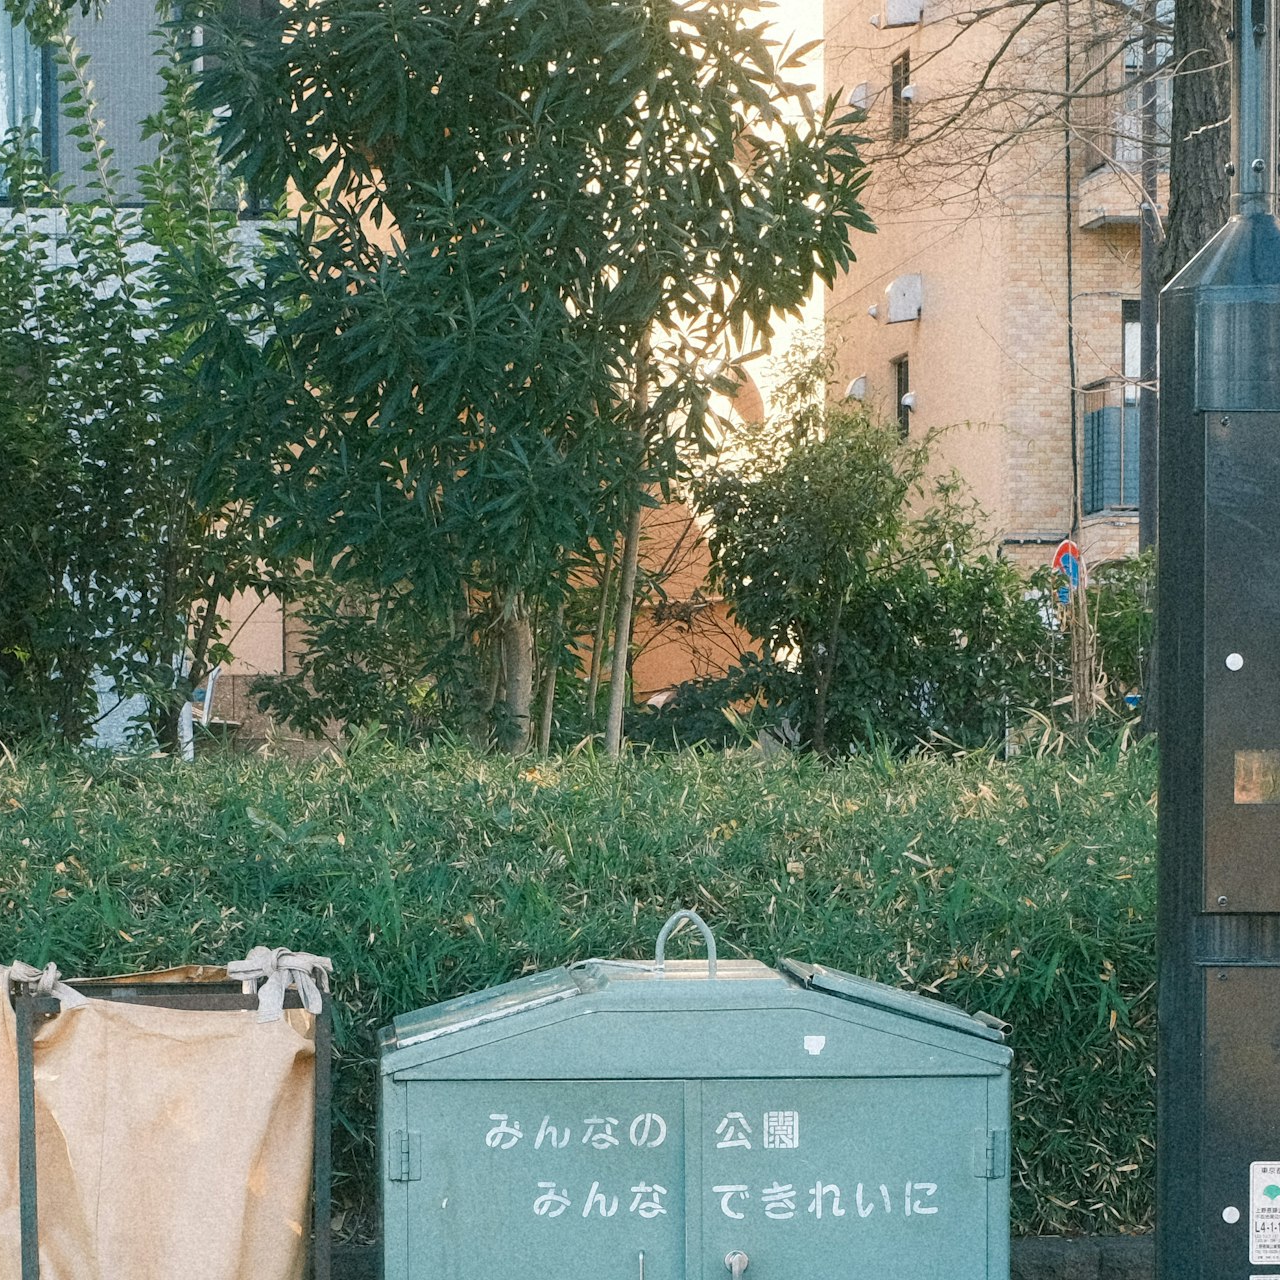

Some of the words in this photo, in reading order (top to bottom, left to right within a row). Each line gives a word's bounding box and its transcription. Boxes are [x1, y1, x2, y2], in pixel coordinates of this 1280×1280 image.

[485, 1113, 667, 1150] みんなの
[715, 1111, 800, 1150] 公園
[533, 1181, 668, 1219] みんな
[712, 1181, 939, 1220] できれいに
